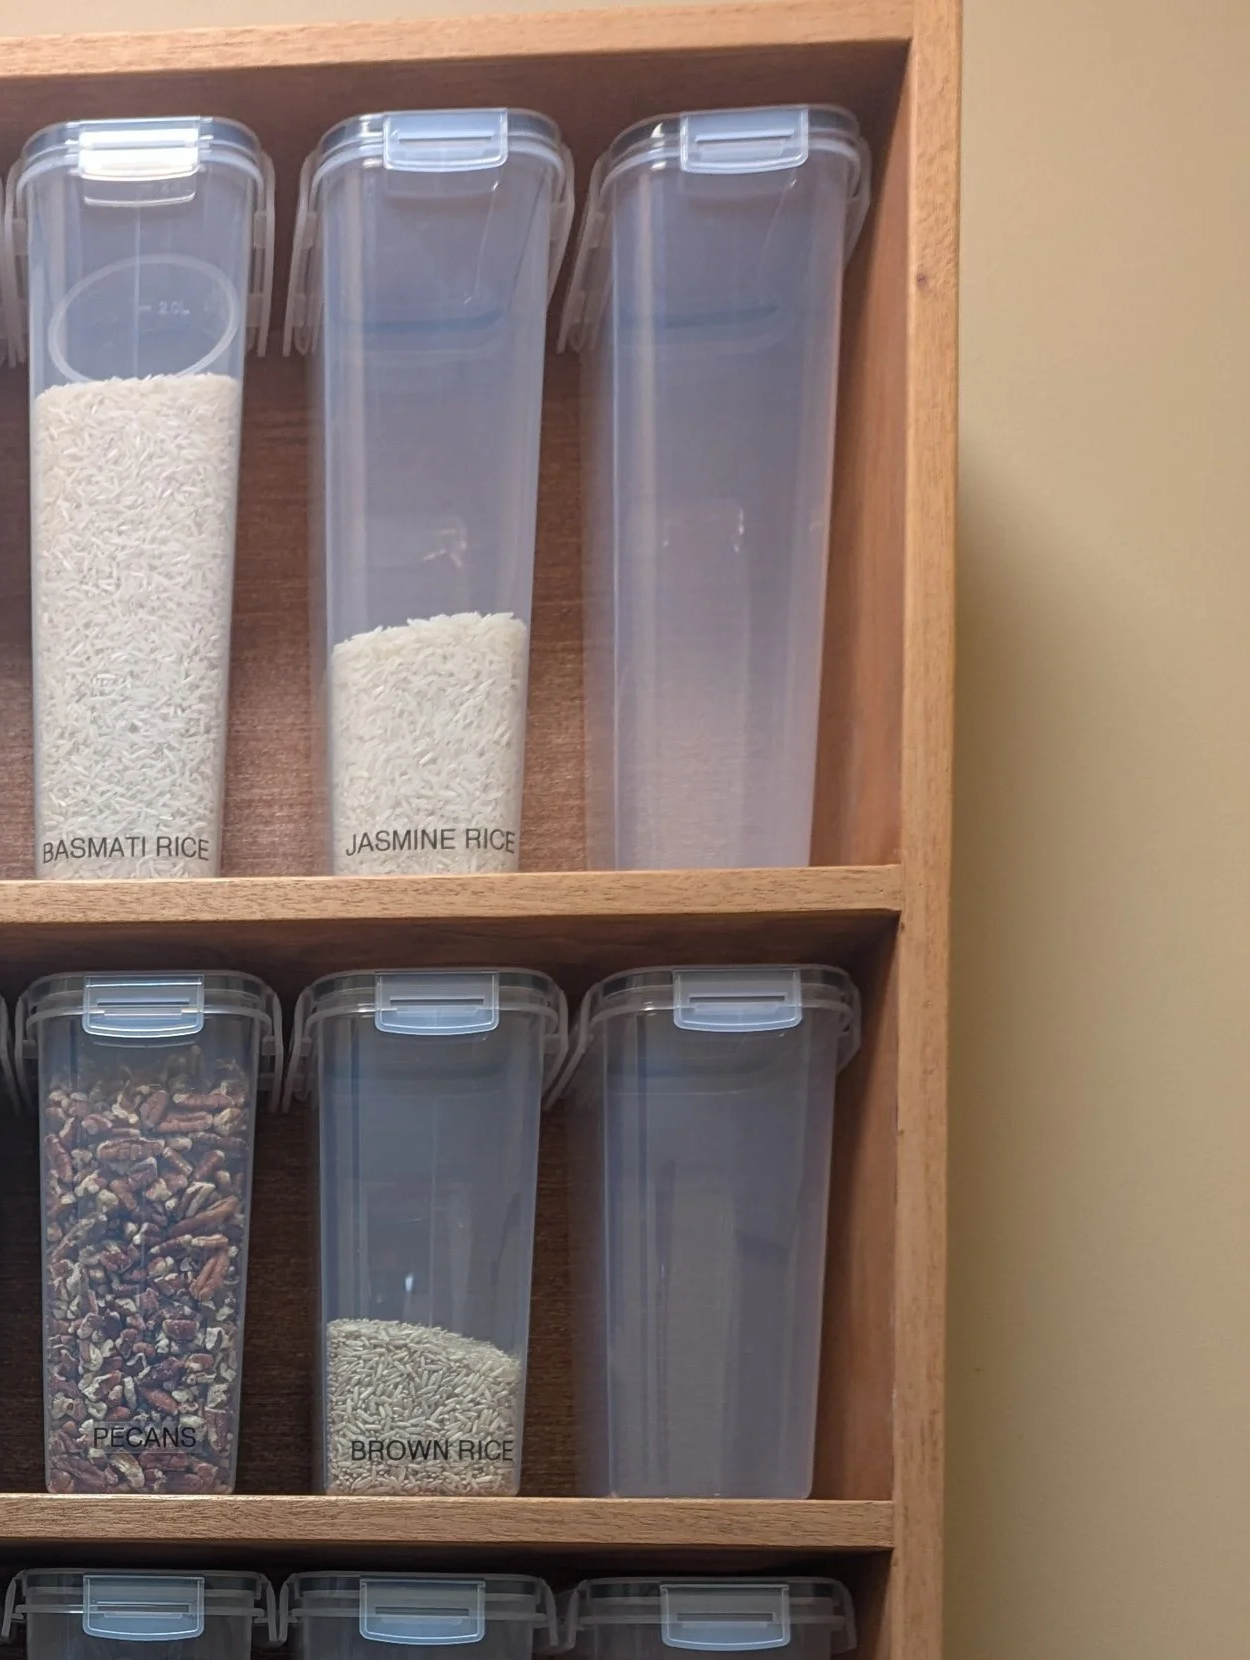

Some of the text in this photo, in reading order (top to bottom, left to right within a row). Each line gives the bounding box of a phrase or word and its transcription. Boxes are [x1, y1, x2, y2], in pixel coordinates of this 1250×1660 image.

[43, 835, 211, 864] BASMATI RICE
[345, 827, 516, 857] JASMINE RICE
[93, 1426, 197, 1449] PECANS
[351, 1437, 514, 1463] BROWN RICE
